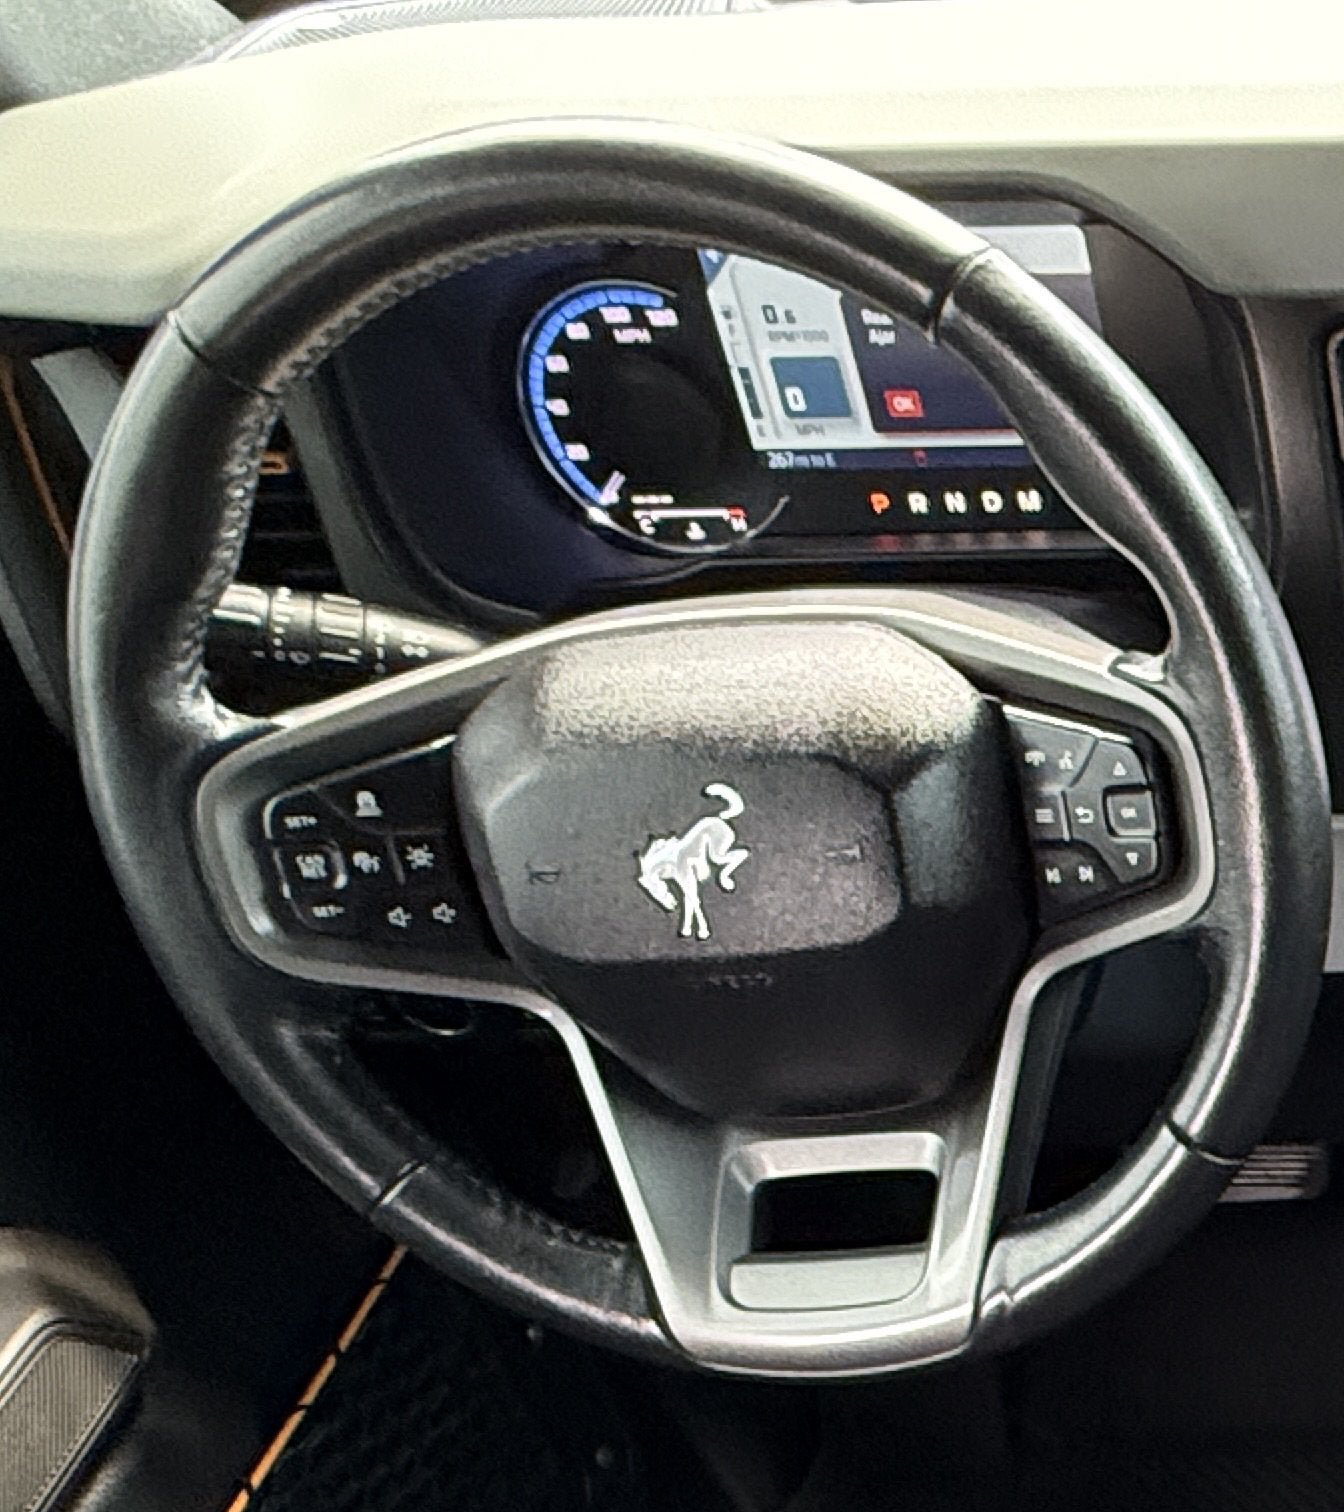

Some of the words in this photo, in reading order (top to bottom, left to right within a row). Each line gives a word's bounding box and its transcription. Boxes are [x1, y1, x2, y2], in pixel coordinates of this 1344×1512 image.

[869, 491, 893, 514] P
[907, 491, 930, 514] R
[943, 490, 967, 513] N
[980, 490, 1003, 513] D
[1017, 490, 1043, 513] M
